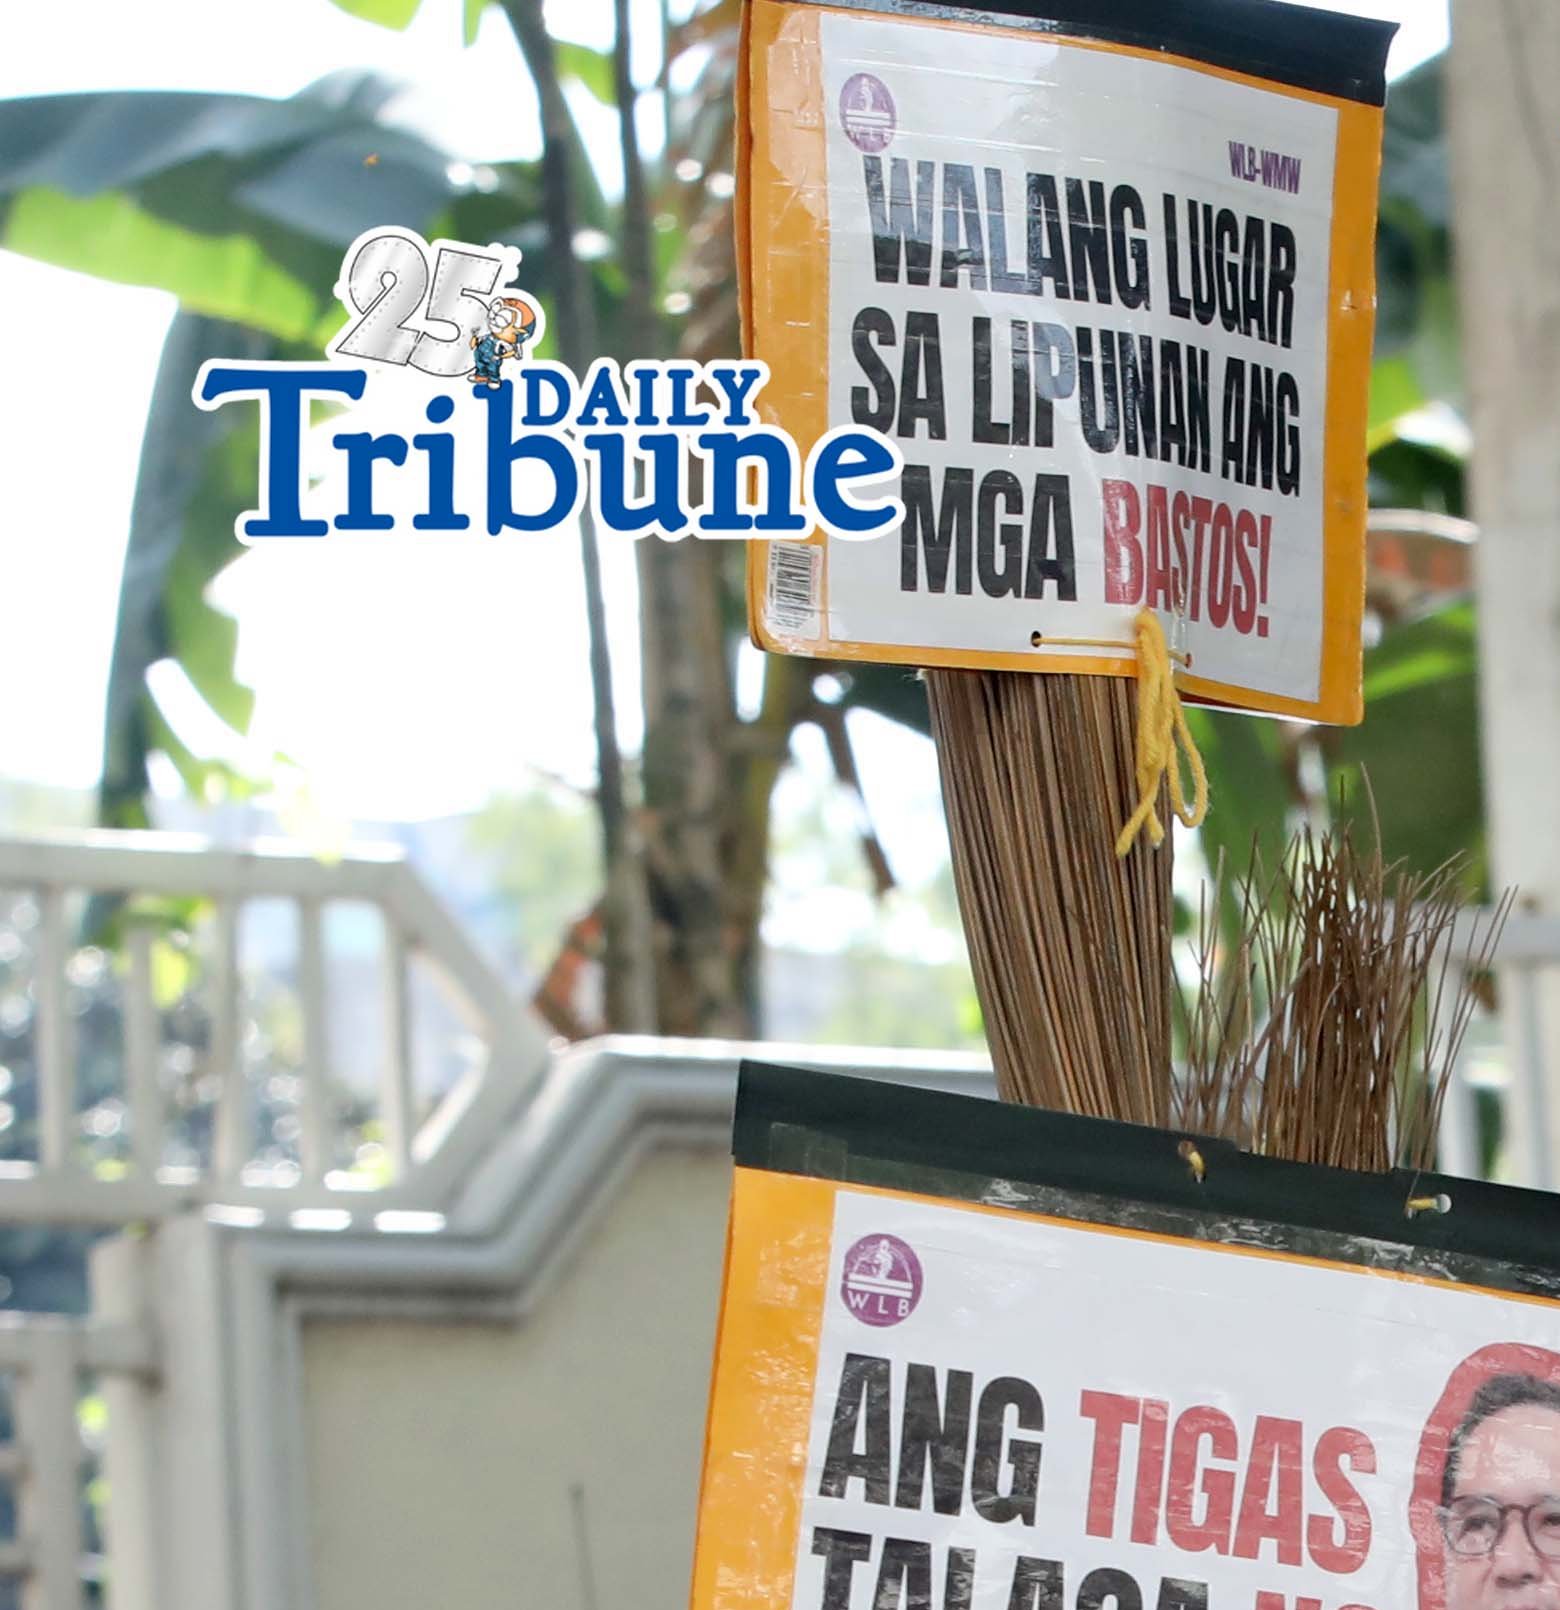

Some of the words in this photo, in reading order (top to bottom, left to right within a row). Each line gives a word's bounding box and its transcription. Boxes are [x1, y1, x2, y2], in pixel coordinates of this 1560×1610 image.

[863, 155, 1151, 311] WALANG
[1162, 193, 1297, 349] LUGAR
[1228, 141, 1301, 194] WLB-WMW
[851, 307, 946, 441] SA
[972, 316, 1212, 474] LIPUNAN
[1221, 358, 1300, 497] ANG
[900, 464, 1077, 602] MGA
[1101, 478, 1272, 638] BASTOS!
[848, 1290, 910, 1317] WLB
[818, 1352, 1045, 1527] ANG
[1079, 1389, 1377, 1575] TIGAS
